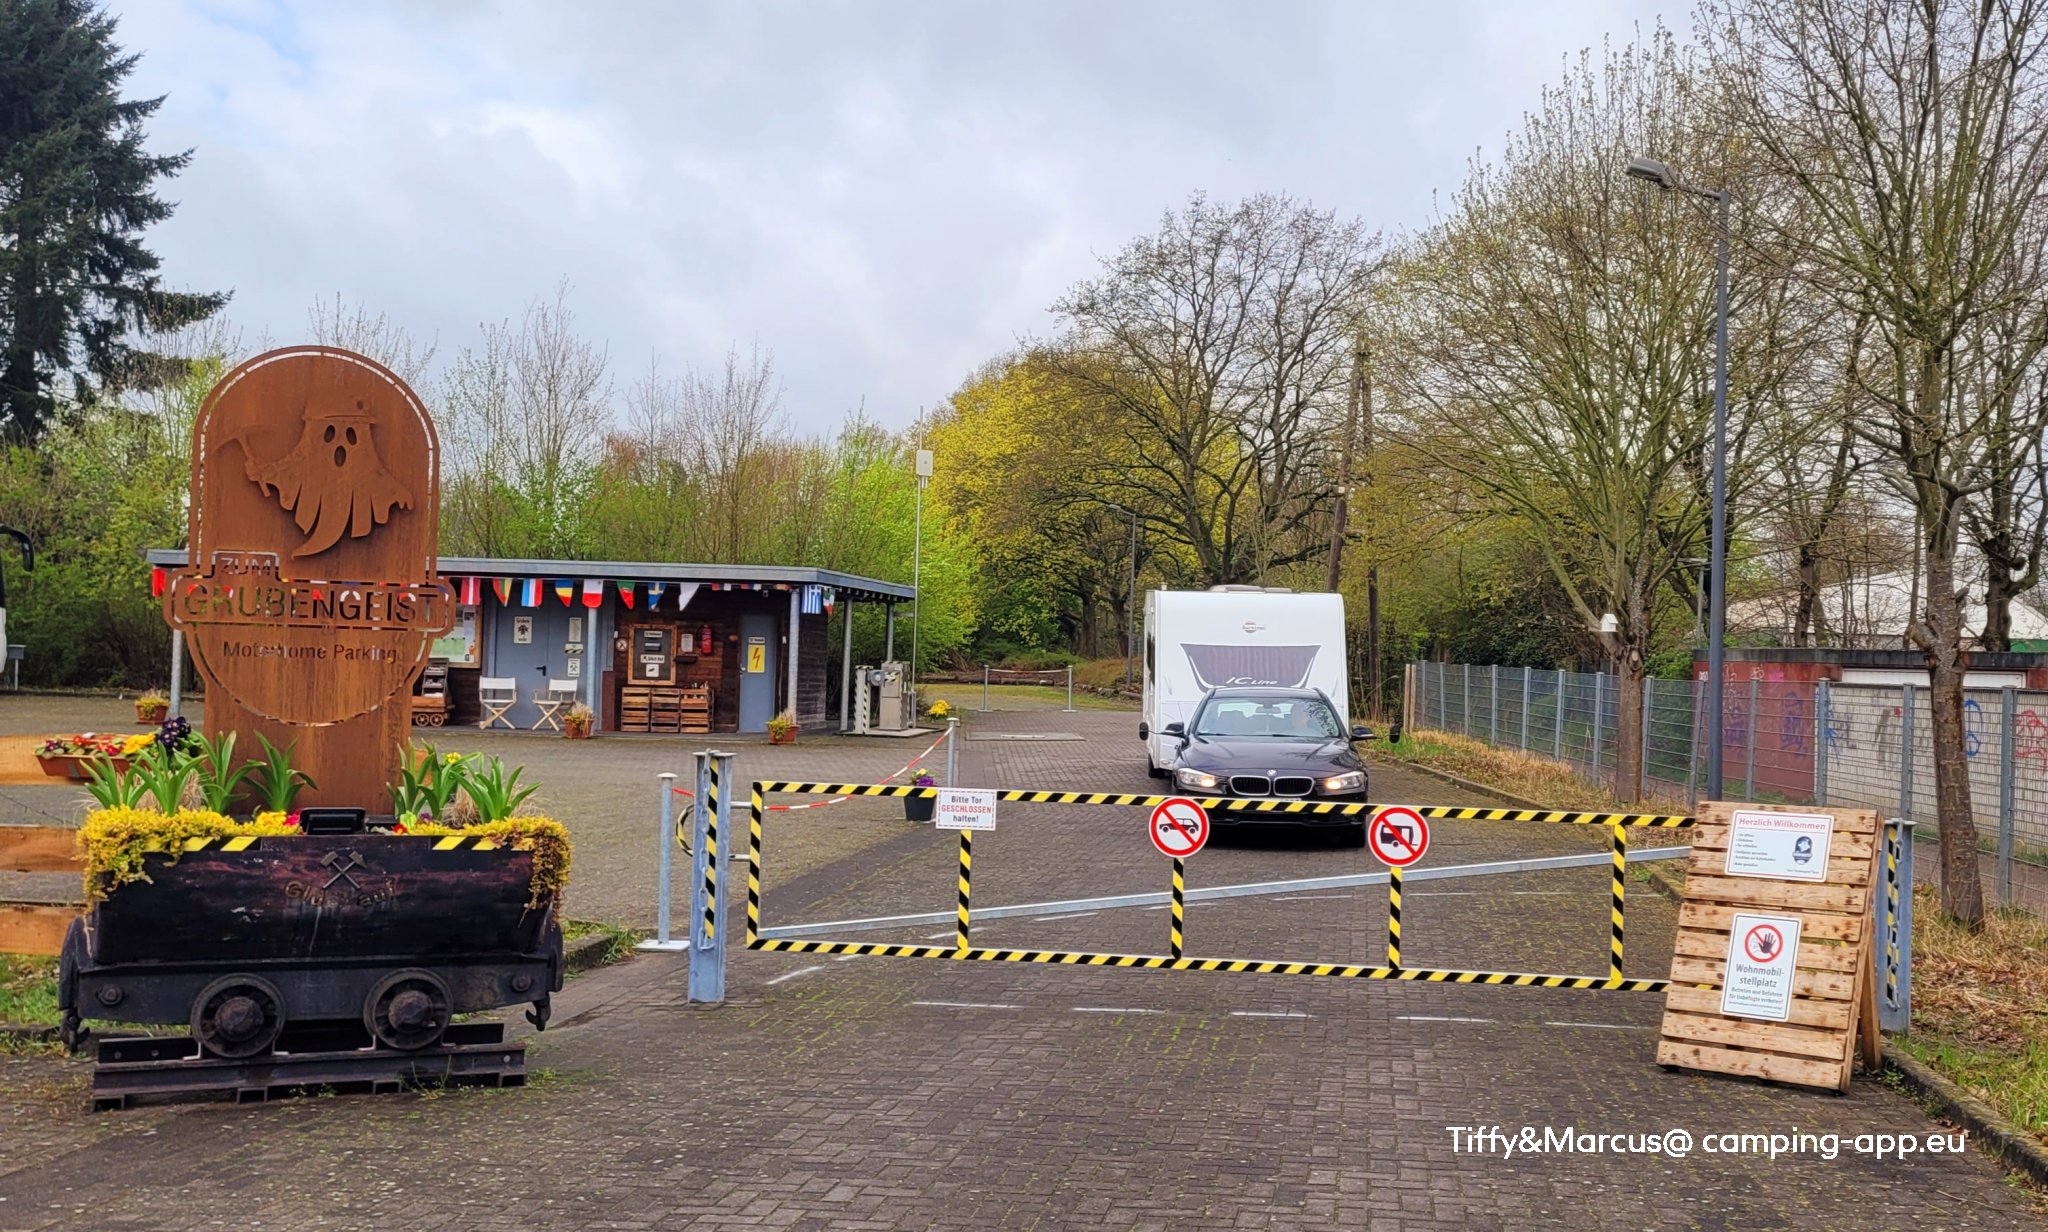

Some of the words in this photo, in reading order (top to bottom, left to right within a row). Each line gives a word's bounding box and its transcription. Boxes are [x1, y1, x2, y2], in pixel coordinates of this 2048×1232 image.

[220, 557, 271, 576] ZUM
[185, 585, 438, 623] GRUBENGEIST
[333, 644, 397, 665] Parking
[951, 796, 969, 804] Bitte
[971, 796, 982, 804] Tor
[941, 805, 992, 813] GESCHLOSSEN
[953, 815, 979, 823] halten!
[1739, 818, 1772, 827] Herzlich
[1774, 820, 1826, 830] Willkommen
[1736, 964, 1785, 976] Wohnmobil-
[1739, 976, 1777, 988] stellplatz
